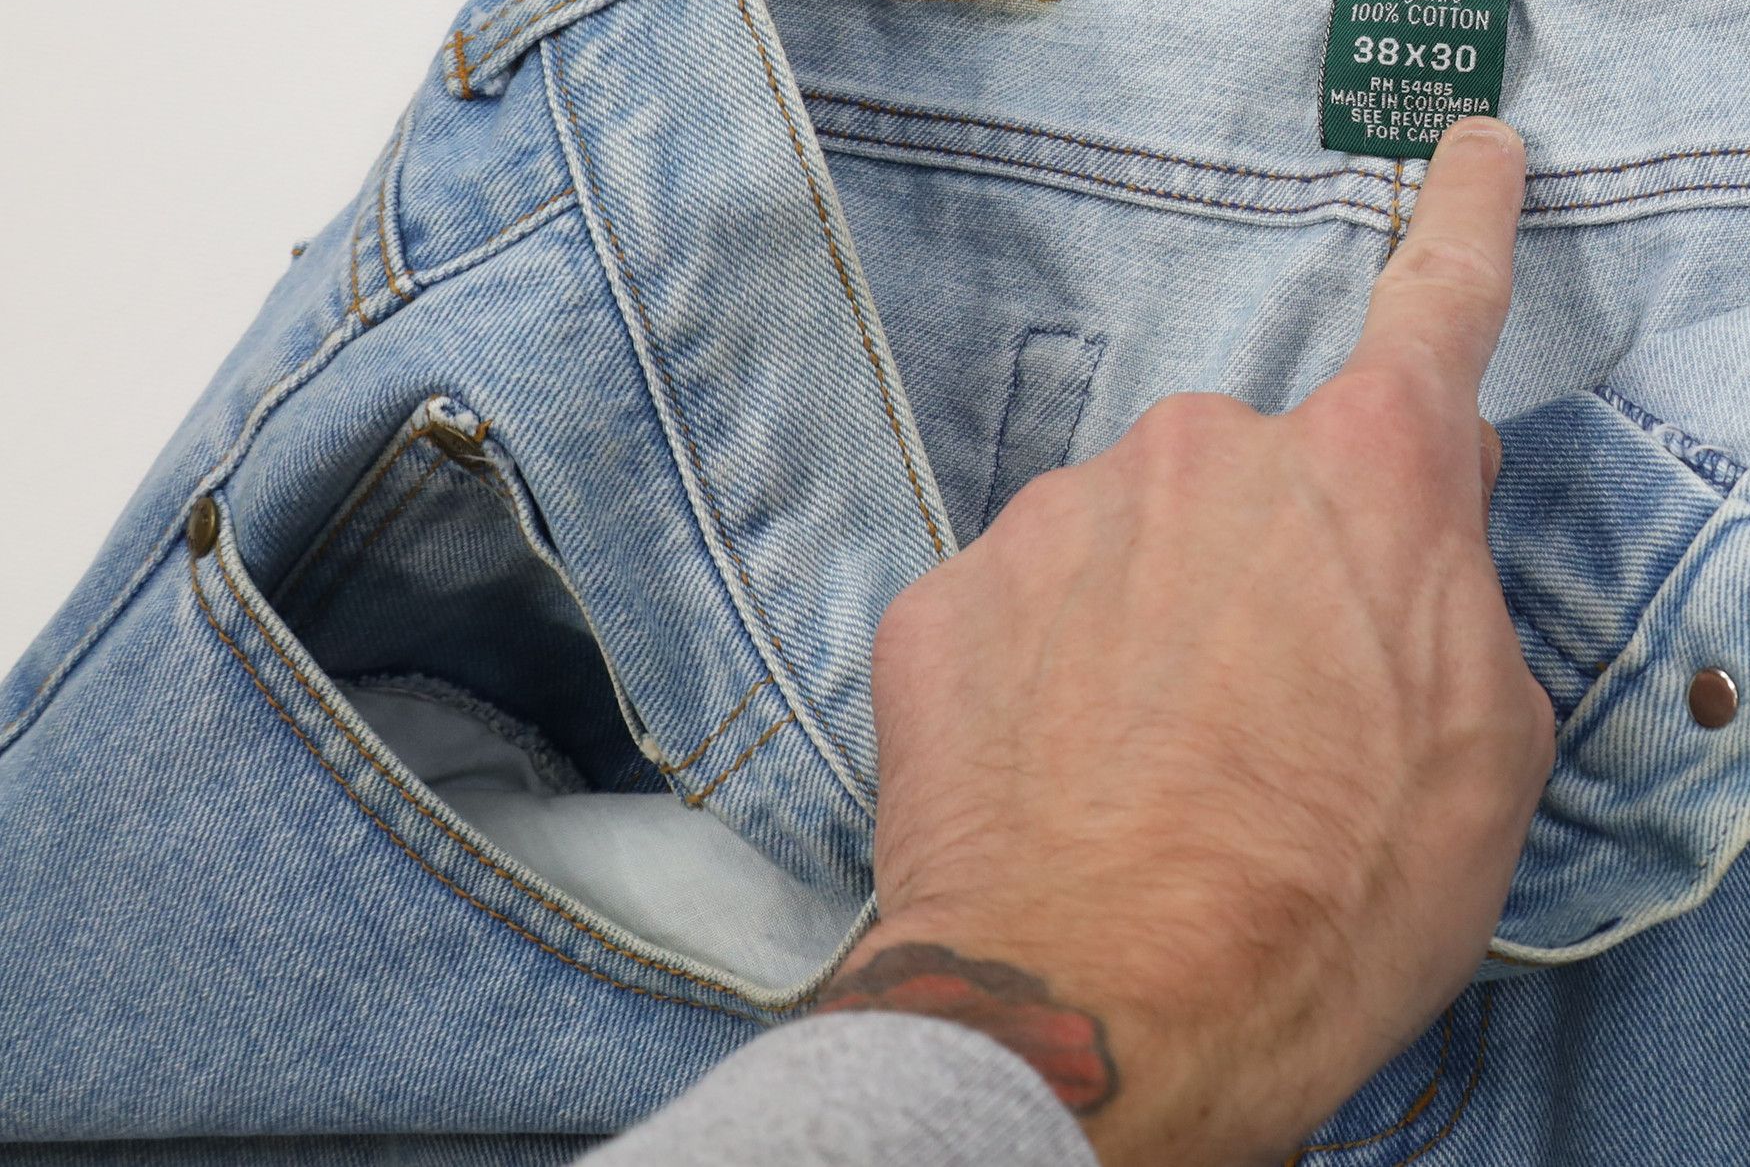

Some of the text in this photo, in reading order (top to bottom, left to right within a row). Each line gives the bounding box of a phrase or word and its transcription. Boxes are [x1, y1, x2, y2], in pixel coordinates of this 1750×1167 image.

[1351, 2, 1490, 30] 100% COTTON
[1370, 76, 1454, 96] RN 54485
[1330, 89, 1490, 113] MADE IN COLOMBIA
[1351, 108, 1468, 129] SEE REVERS
[1366, 124, 1446, 144] FOR CAR
